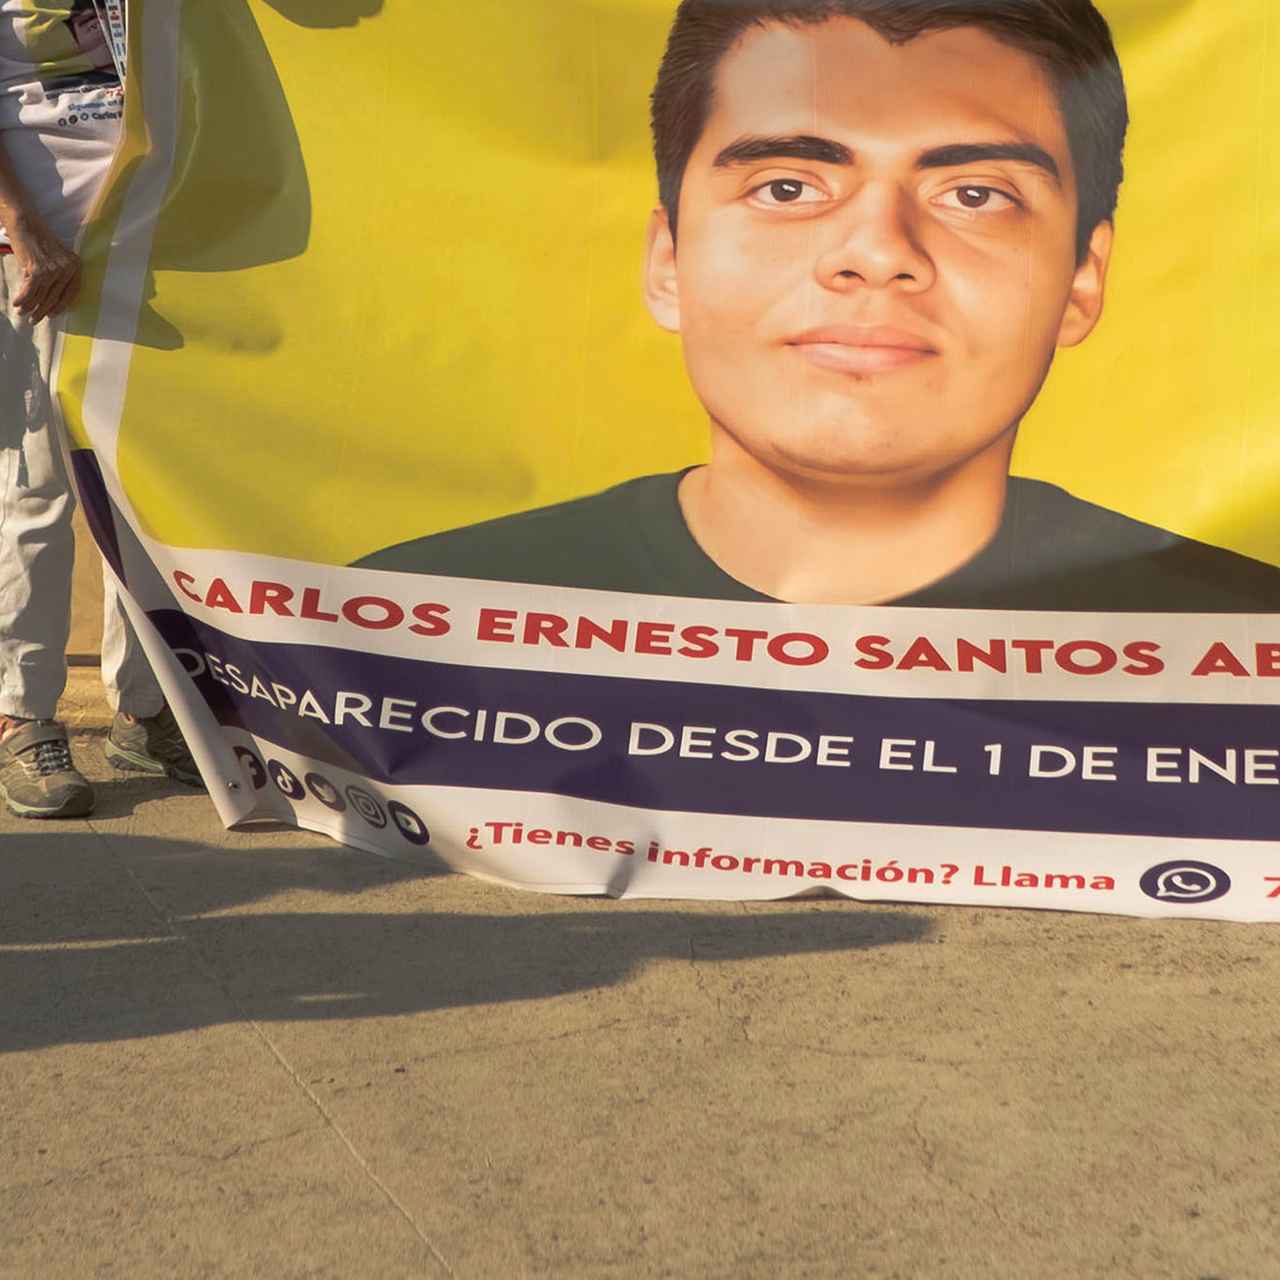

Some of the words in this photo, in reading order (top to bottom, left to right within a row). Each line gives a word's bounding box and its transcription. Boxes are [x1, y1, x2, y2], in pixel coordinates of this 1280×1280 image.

[173, 570, 450, 636] CARLOS
[477, 607, 828, 666] ERNESTO
[854, 635, 1164, 676] SANTOS
[171, 648, 602, 751] DESAPARECIDO
[628, 722, 854, 767] DESDE
[879, 738, 958, 773] EL
[984, 743, 1002, 776] 1
[1028, 745, 1118, 781] DE
[465, 821, 635, 856] ¿Tienes
[647, 840, 959, 886] información?
[974, 865, 1116, 892] Llama
